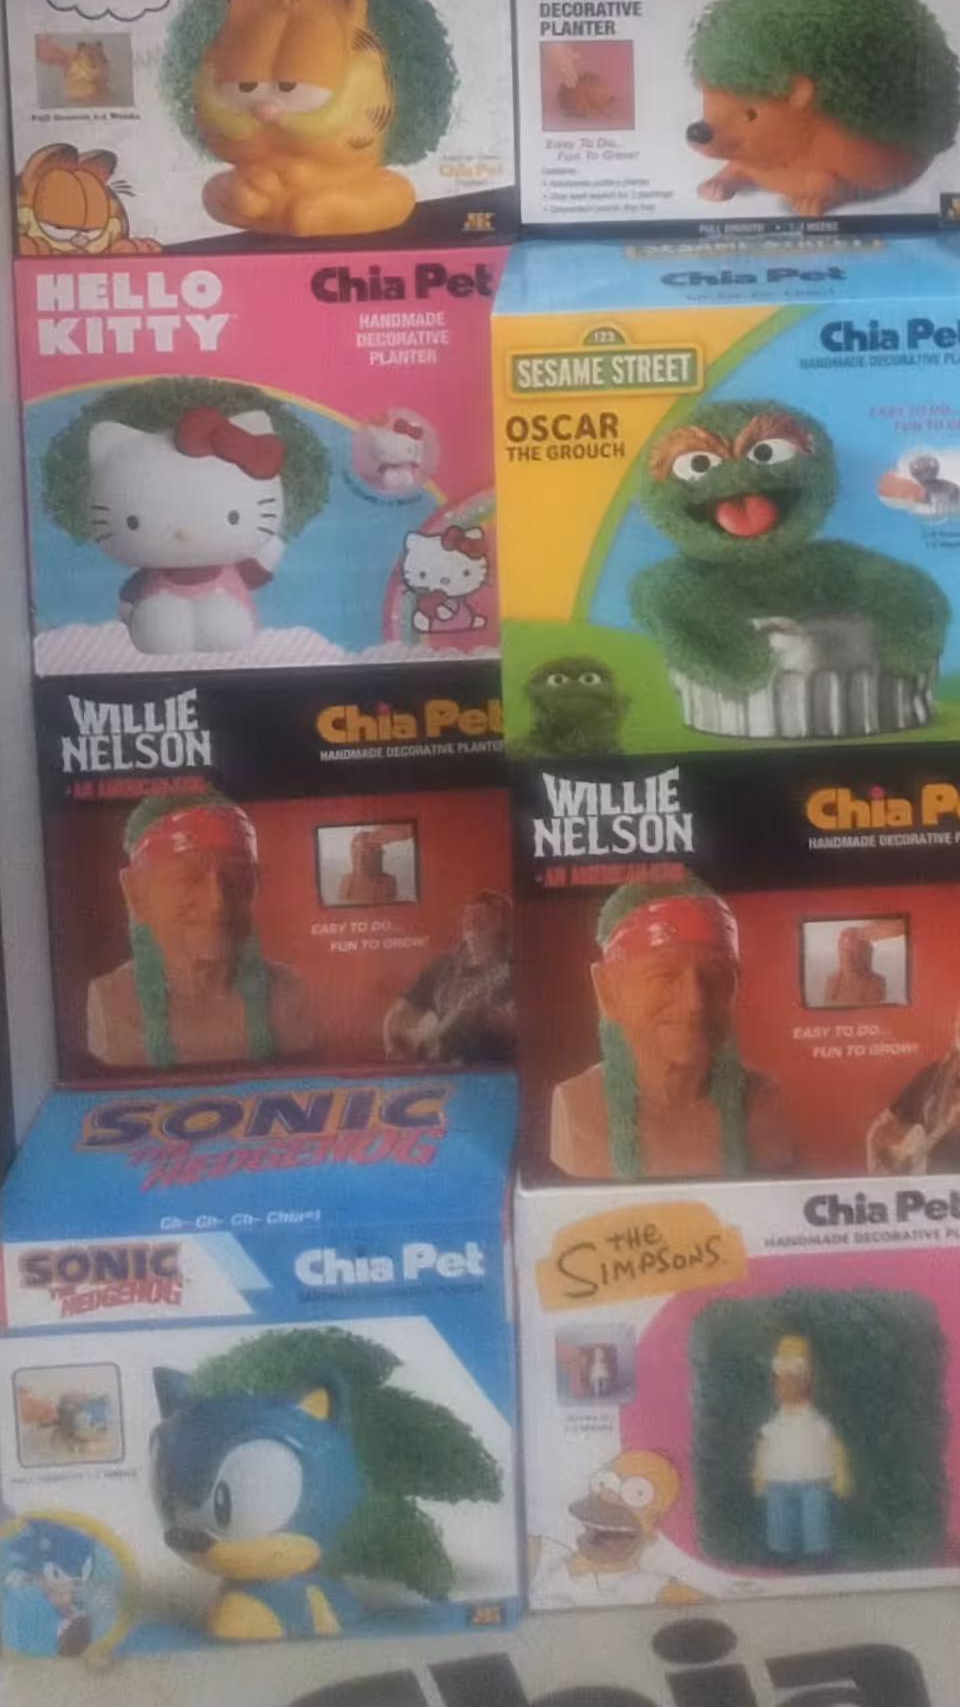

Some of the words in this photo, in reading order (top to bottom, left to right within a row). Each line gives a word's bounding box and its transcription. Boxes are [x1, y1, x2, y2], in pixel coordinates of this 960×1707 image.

[539, 1, 642, 18] DECORATIVE
[540, 20, 616, 36] PLANTER
[36, 269, 223, 312] HELLO
[310, 266, 406, 304] Chia
[415, 262, 495, 300] Pet
[661, 270, 758, 287] Chia
[766, 266, 846, 284] Pet
[37, 313, 231, 356] KITTY
[359, 312, 446, 328] HANDMADE
[820, 320, 899, 352] Chia
[356, 330, 449, 347] DECORATIVE
[370, 349, 437, 366] PLANTER
[517, 355, 606, 390] SESAME
[611, 353, 692, 387] STREET
[800, 355, 865, 370] HANDMADE
[505, 413, 619, 443] OSCAR
[506, 446, 541, 463] THE
[546, 442, 625, 461] GROUCH
[68, 688, 199, 735] WILLIE
[317, 702, 417, 744] Chia
[61, 730, 212, 773] NELSON
[541, 766, 680, 816] WILLIE
[806, 785, 913, 831] Chia
[533, 813, 693, 858] NELSON
[809, 834, 876, 850] HANDMADE
[879, 832, 952, 847] DECORATIVE
[793, 1026, 830, 1040] EASY
[834, 1025, 853, 1038] TO
[812, 1045, 843, 1059] FUN
[847, 1044, 866, 1057] TO
[76, 1082, 454, 1151] SONIC
[804, 1194, 889, 1228] Chia
[764, 1233, 850, 1249] HANDMADE
[854, 1229, 941, 1245] DECORATIVE
[18, 1244, 183, 1289] SONIC
[294, 1246, 395, 1288] Chia
[403, 1241, 485, 1281] Pet
